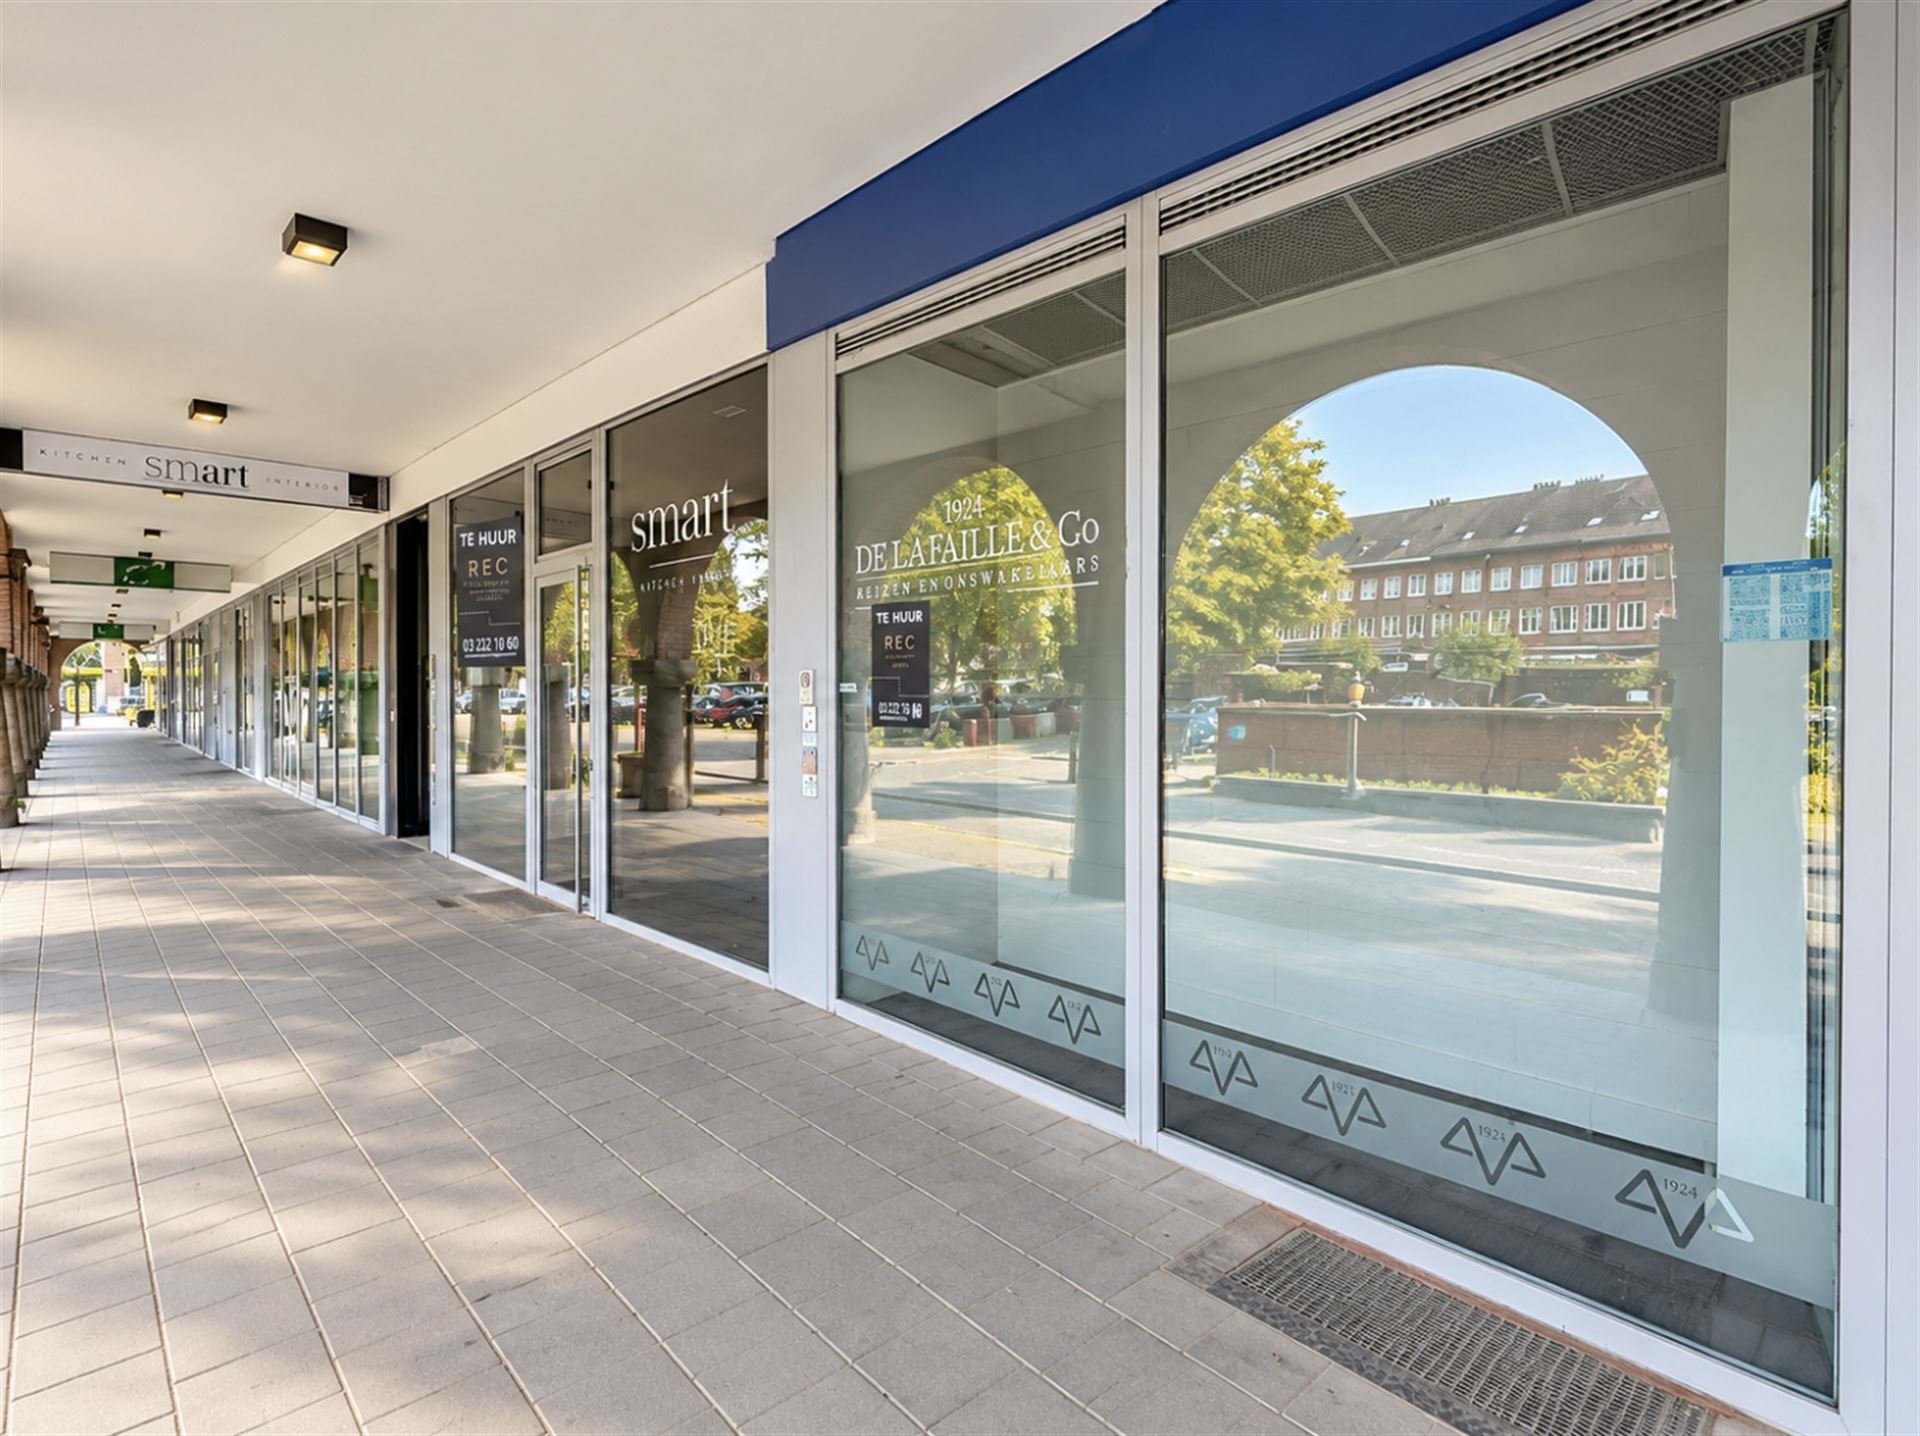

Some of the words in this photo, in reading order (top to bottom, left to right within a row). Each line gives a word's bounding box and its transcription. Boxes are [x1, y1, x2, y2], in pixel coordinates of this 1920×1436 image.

[39, 448, 127, 466] KITCHEN
[144, 455, 250, 489] smart
[266, 477, 340, 492] INTERIOR
[631, 478, 736, 553] smart
[943, 494, 986, 525] 1924
[459, 531, 475, 548] TE
[478, 529, 517, 547] HUUR
[855, 541, 888, 575] DE
[891, 520, 1025, 571] LAFAILLE
[1029, 519, 1052, 552] &
[468, 556, 509, 578] REC
[856, 580, 911, 600] REIZEN
[875, 611, 890, 624] TE
[891, 610, 924, 624] HUUR
[884, 634, 915, 651] REC
[1662, 1177, 1699, 1200] 1924
